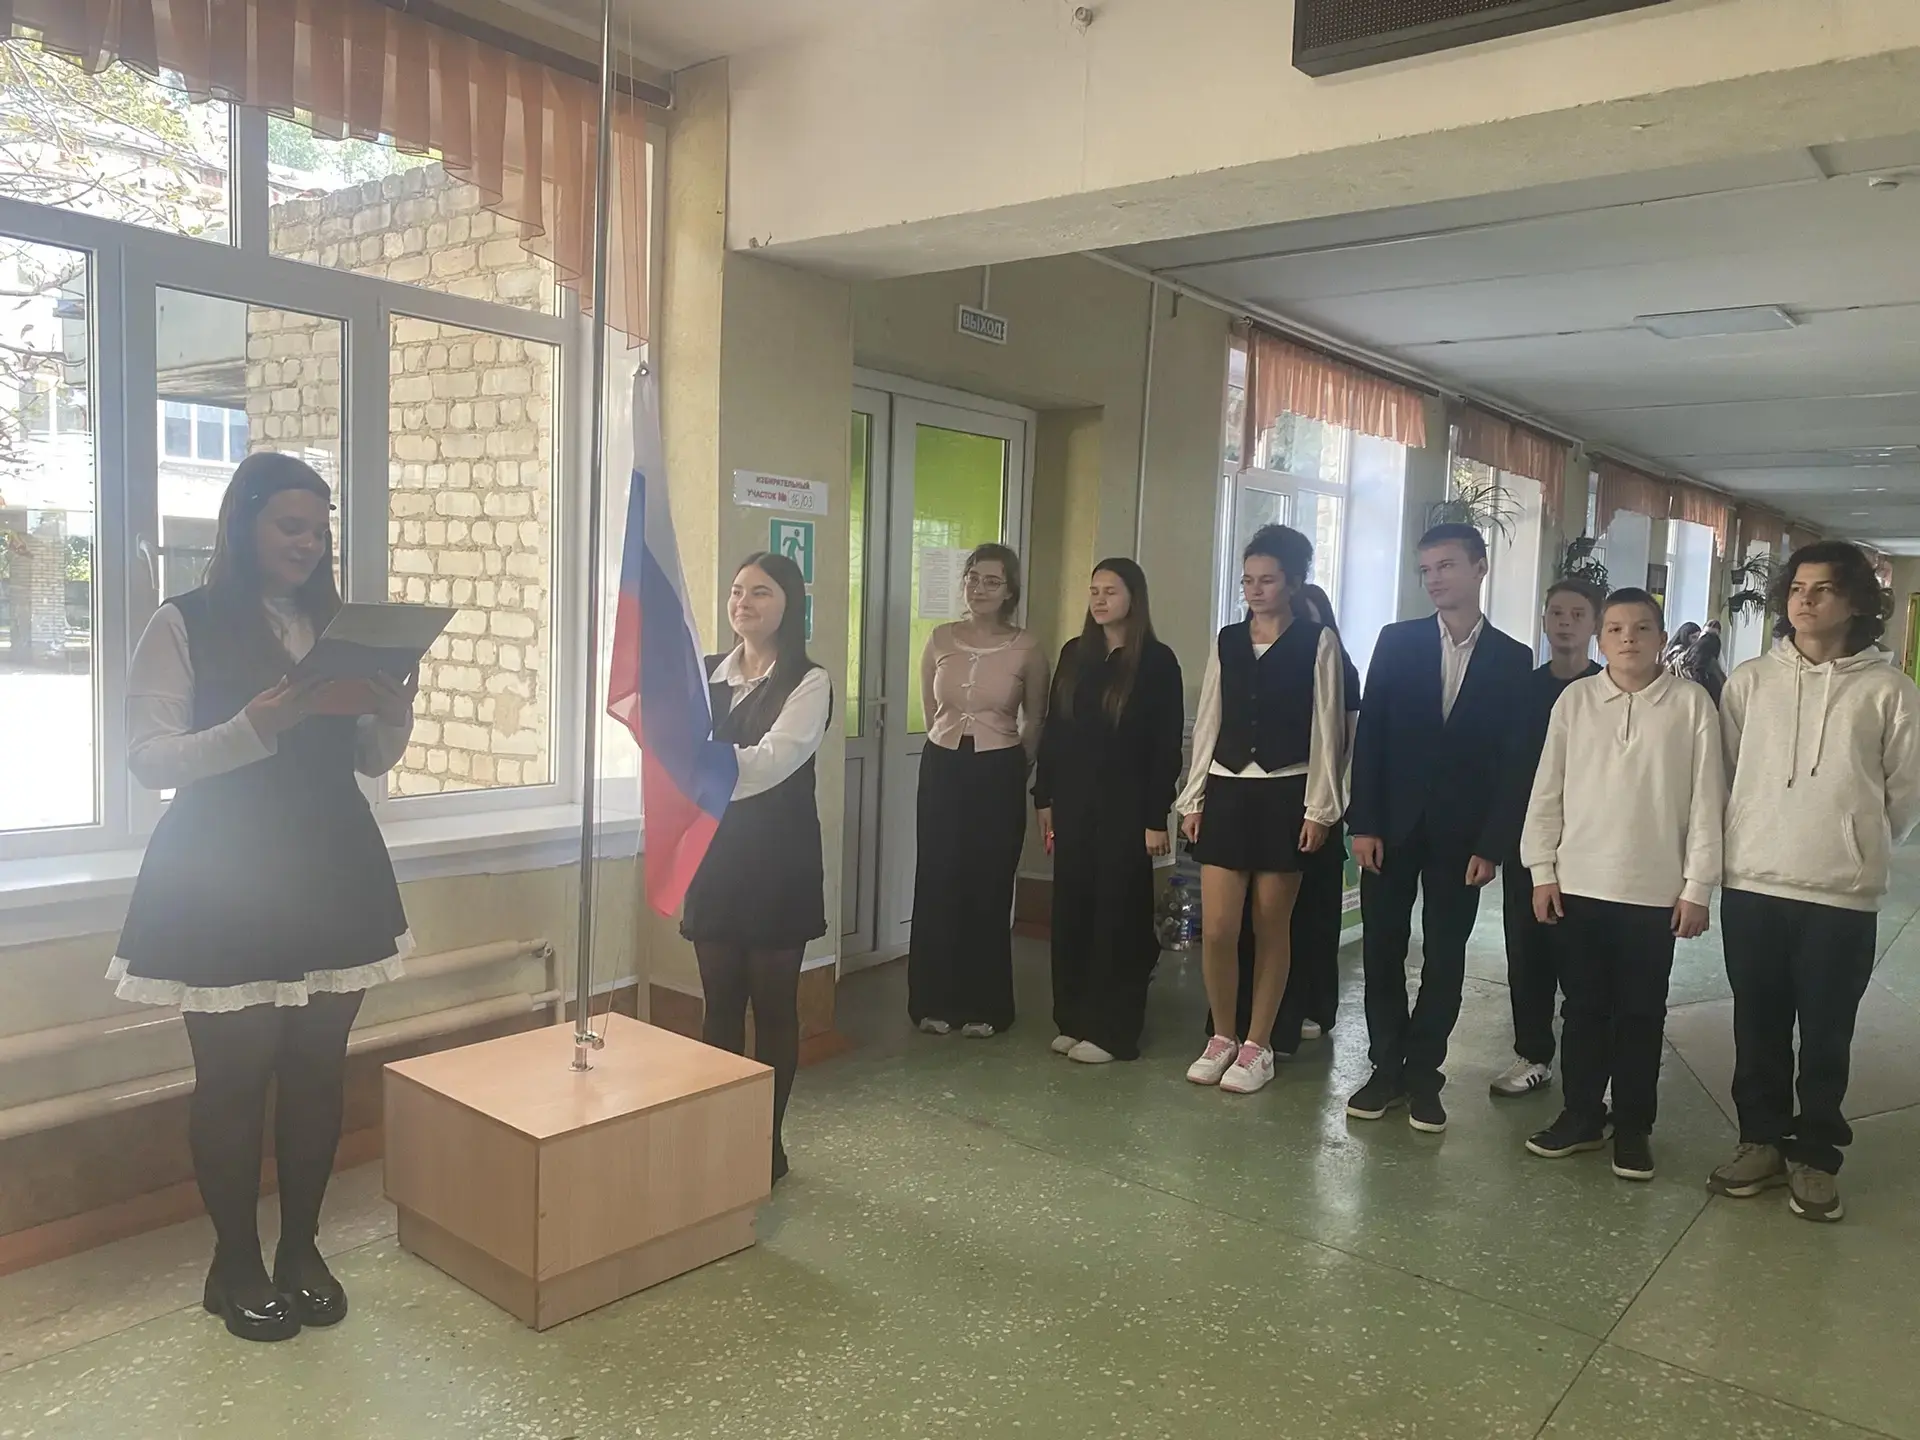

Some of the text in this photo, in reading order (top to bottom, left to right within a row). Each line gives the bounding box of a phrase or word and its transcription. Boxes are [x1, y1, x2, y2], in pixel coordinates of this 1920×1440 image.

[963, 312, 1002, 339] ВЫХОД
[756, 476, 810, 490] ИЗБИРАТЕЛЬНЫЙ
[746, 488, 777, 501] УЧАСТОК
